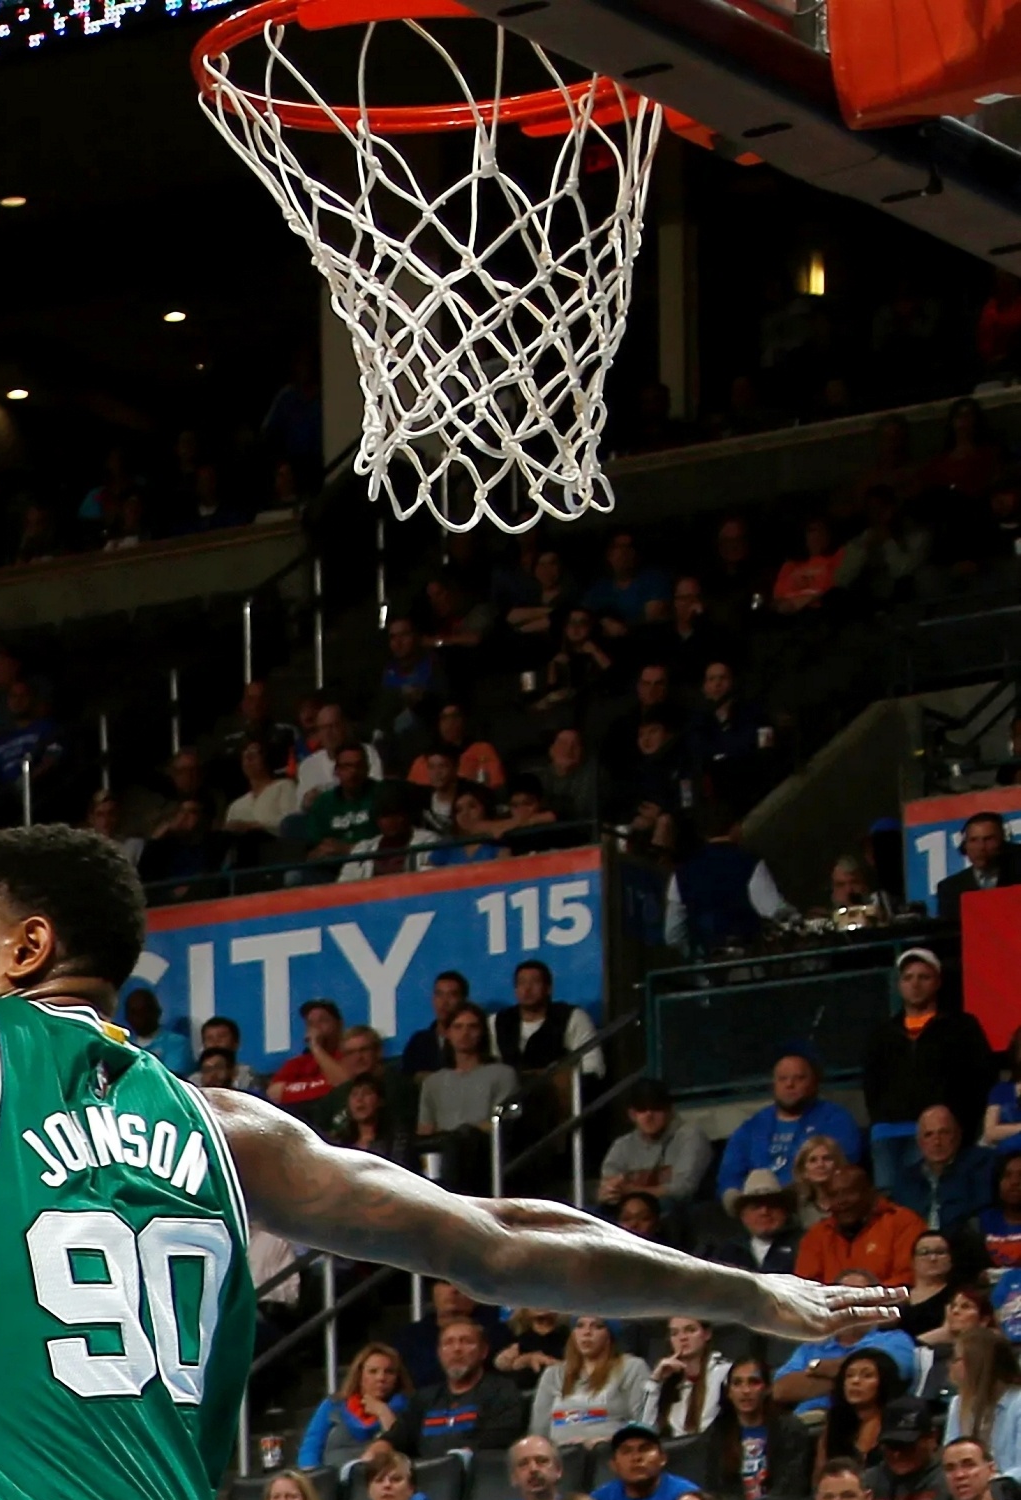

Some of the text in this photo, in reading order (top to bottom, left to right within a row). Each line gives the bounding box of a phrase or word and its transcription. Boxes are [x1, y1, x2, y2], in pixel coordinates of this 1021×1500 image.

[478, 880, 593, 955] 115
[132, 911, 436, 1058] ITY
[22, 1106, 208, 1195] JOHNSON
[26, 1211, 232, 1405] 90
